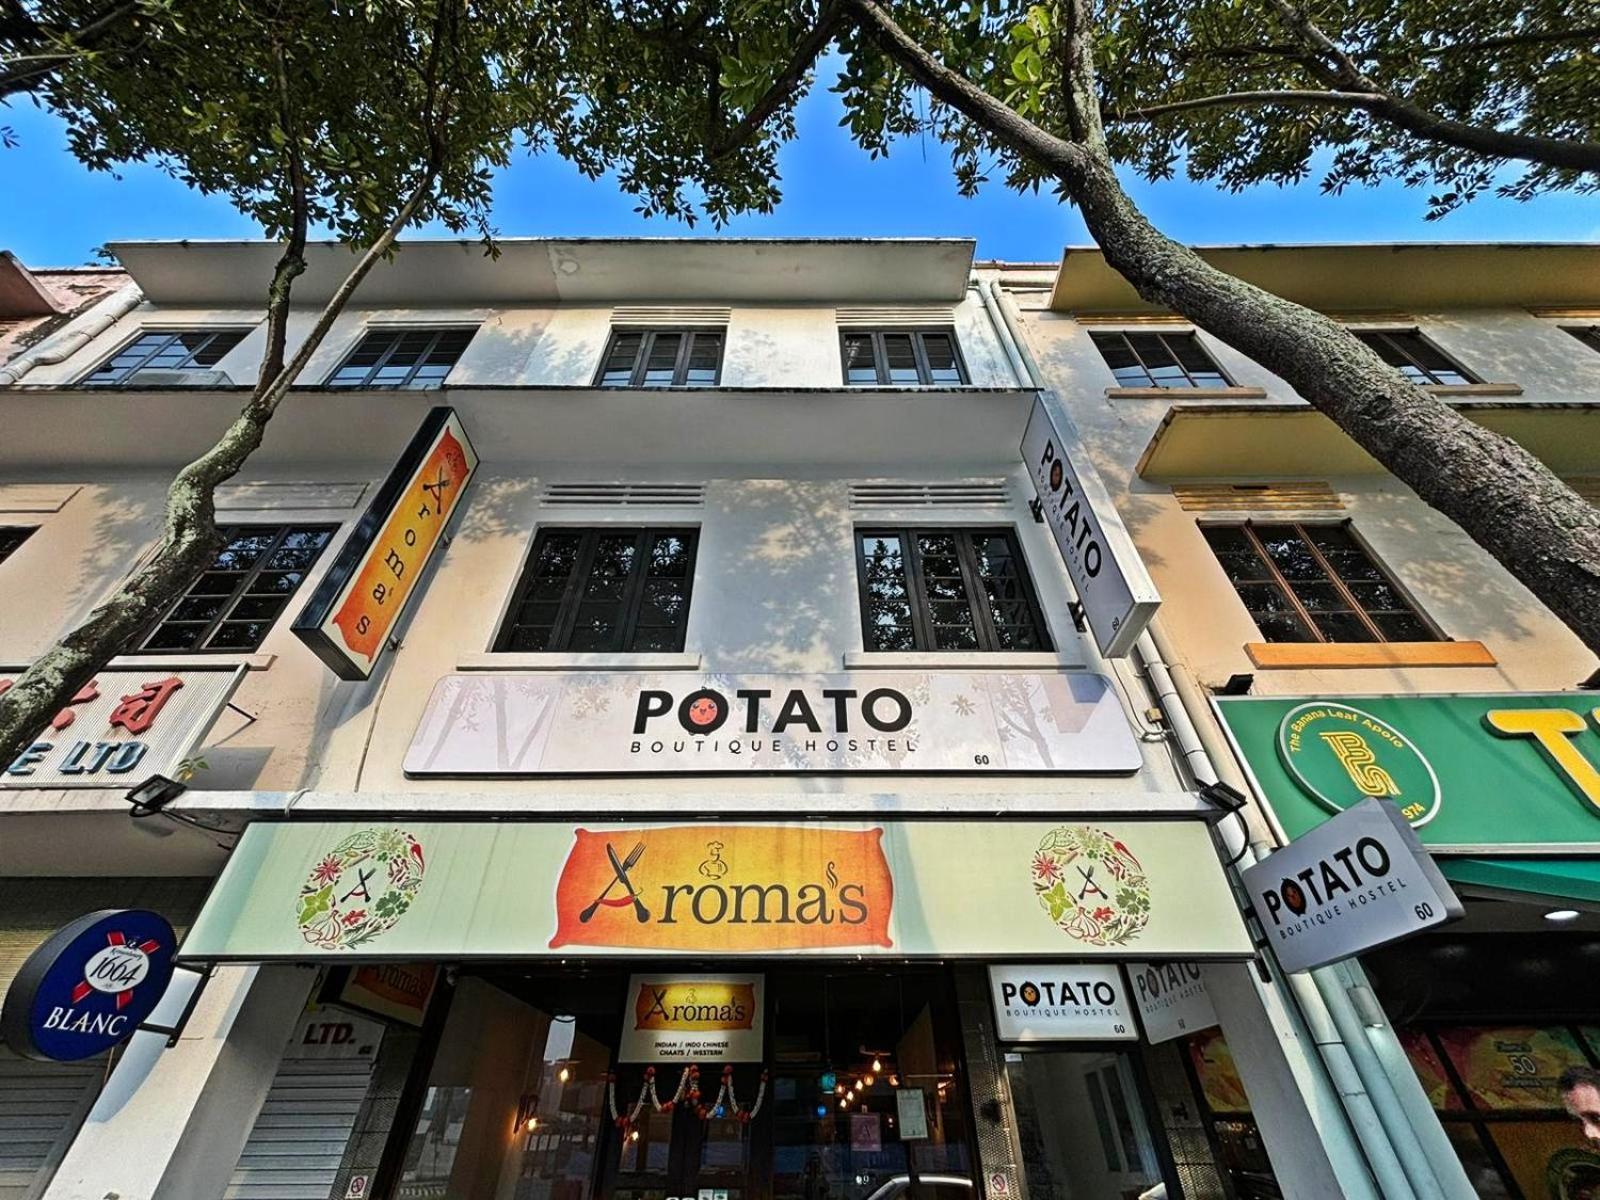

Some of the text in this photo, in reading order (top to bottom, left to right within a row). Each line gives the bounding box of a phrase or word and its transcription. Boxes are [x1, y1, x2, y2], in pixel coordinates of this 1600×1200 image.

[1041, 438, 1102, 578] POTATO
[633, 686, 912, 736] POTATO
[1289, 708, 1404, 752] The Banana Leaf Apolo
[58, 741, 149, 775] LTD
[630, 739, 917, 755] BOUTIQUE HOSTEL
[974, 754, 990, 765] 60
[1401, 802, 1426, 819] 974
[579, 841, 868, 925] Aroma's
[1262, 836, 1390, 925] POTATO
[1280, 878, 1407, 940] BOUTIQUE HOSTEL
[1414, 901, 1434, 921] 60
[89, 955, 143, 986] 1664
[644, 987, 746, 1022] Aroma's
[1001, 981, 1115, 1007] POTATO
[43, 1006, 128, 1036] BLANC
[1007, 1008, 1067, 1017] BOUTIQUE
[303, 1023, 356, 1045] LTD.
[1114, 1024, 1125, 1034] 60
[1509, 1054, 1536, 1075] 50
